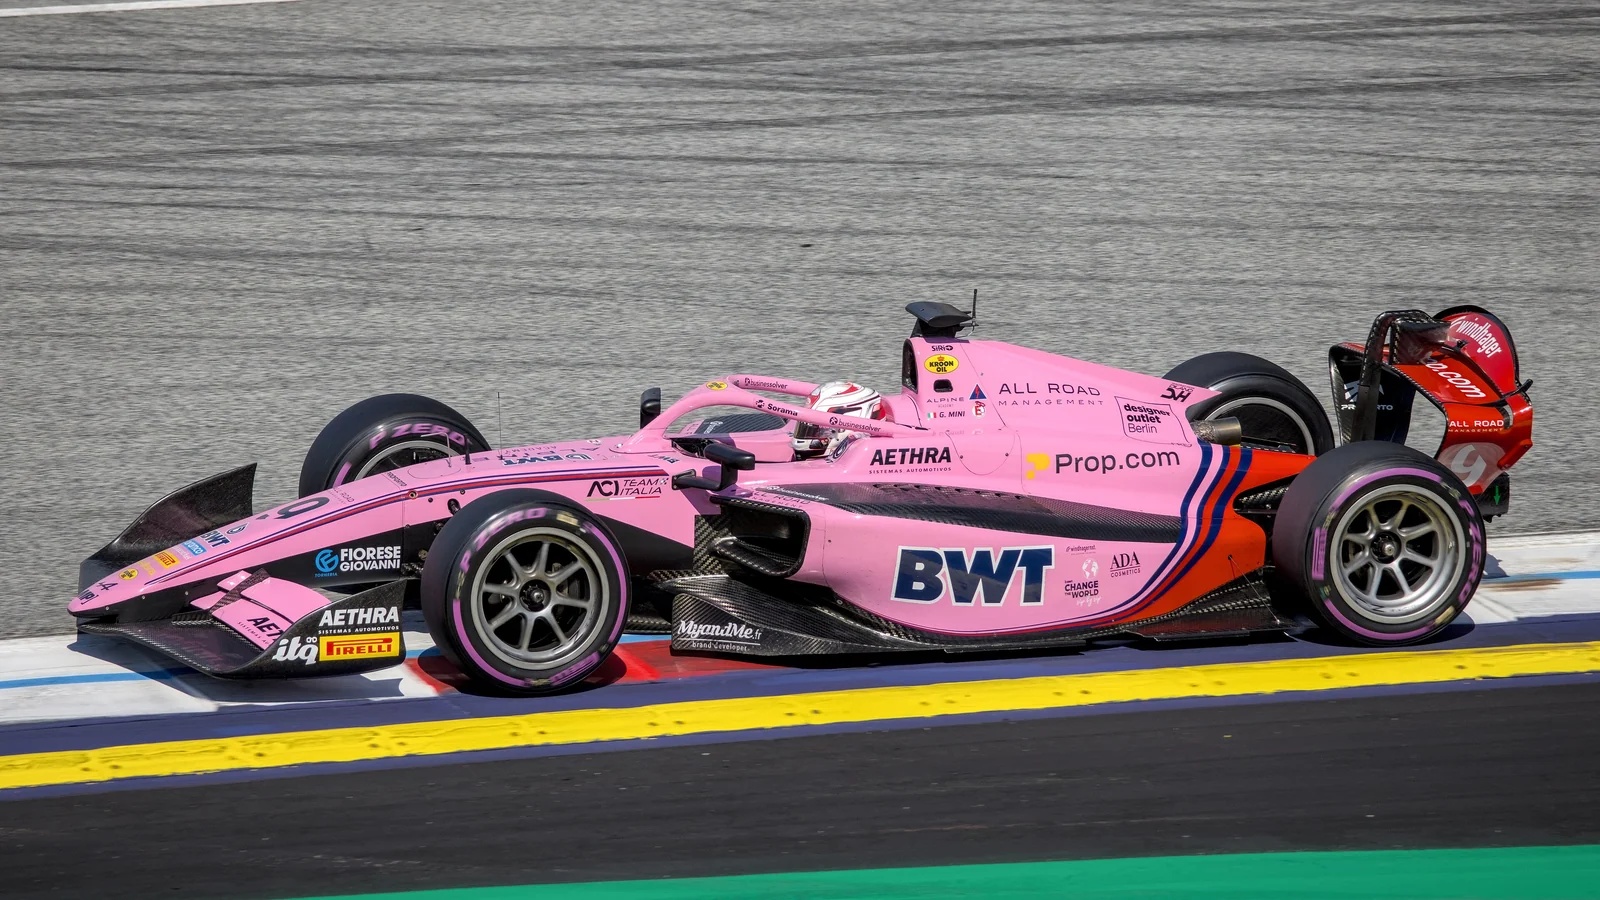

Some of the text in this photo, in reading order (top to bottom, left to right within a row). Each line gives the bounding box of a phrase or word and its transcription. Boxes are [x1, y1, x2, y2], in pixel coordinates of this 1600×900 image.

[1455, 317, 1502, 358] windhager
[929, 360, 954, 368] KROON
[750, 379, 788, 390] businessolver
[999, 382, 1101, 396] ALL ROAD
[767, 403, 798, 417] Sorama
[948, 410, 965, 418] MINI
[1123, 403, 1170, 417] designer
[838, 418, 882, 433] businessolver
[1127, 413, 1161, 424] outlet
[1474, 419, 1504, 427] ROAD
[391, 423, 468, 447] ZERO
[1127, 423, 1158, 434] Berlin
[870, 446, 952, 466] AETHRA
[1055, 450, 1181, 474] Prop.com
[586, 480, 620, 497] ACI
[623, 478, 660, 487] TEAM
[619, 486, 662, 496] ITALIA
[200, 530, 231, 547] BWT
[340, 545, 401, 561] FIORESE
[339, 558, 401, 572] GIOVANNI
[1109, 551, 1141, 570] ADA
[892, 545, 1053, 606] BWT
[1110, 568, 1141, 578] COSMETICS
[1065, 580, 1099, 592] CHANGE
[1071, 588, 1099, 599] WORLD
[318, 606, 400, 627] AETHRA
[246, 616, 284, 642] AET
[677, 620, 762, 640] MyandMe.fr
[326, 637, 393, 656] PIRELLI
[692, 641, 712, 649] brand
